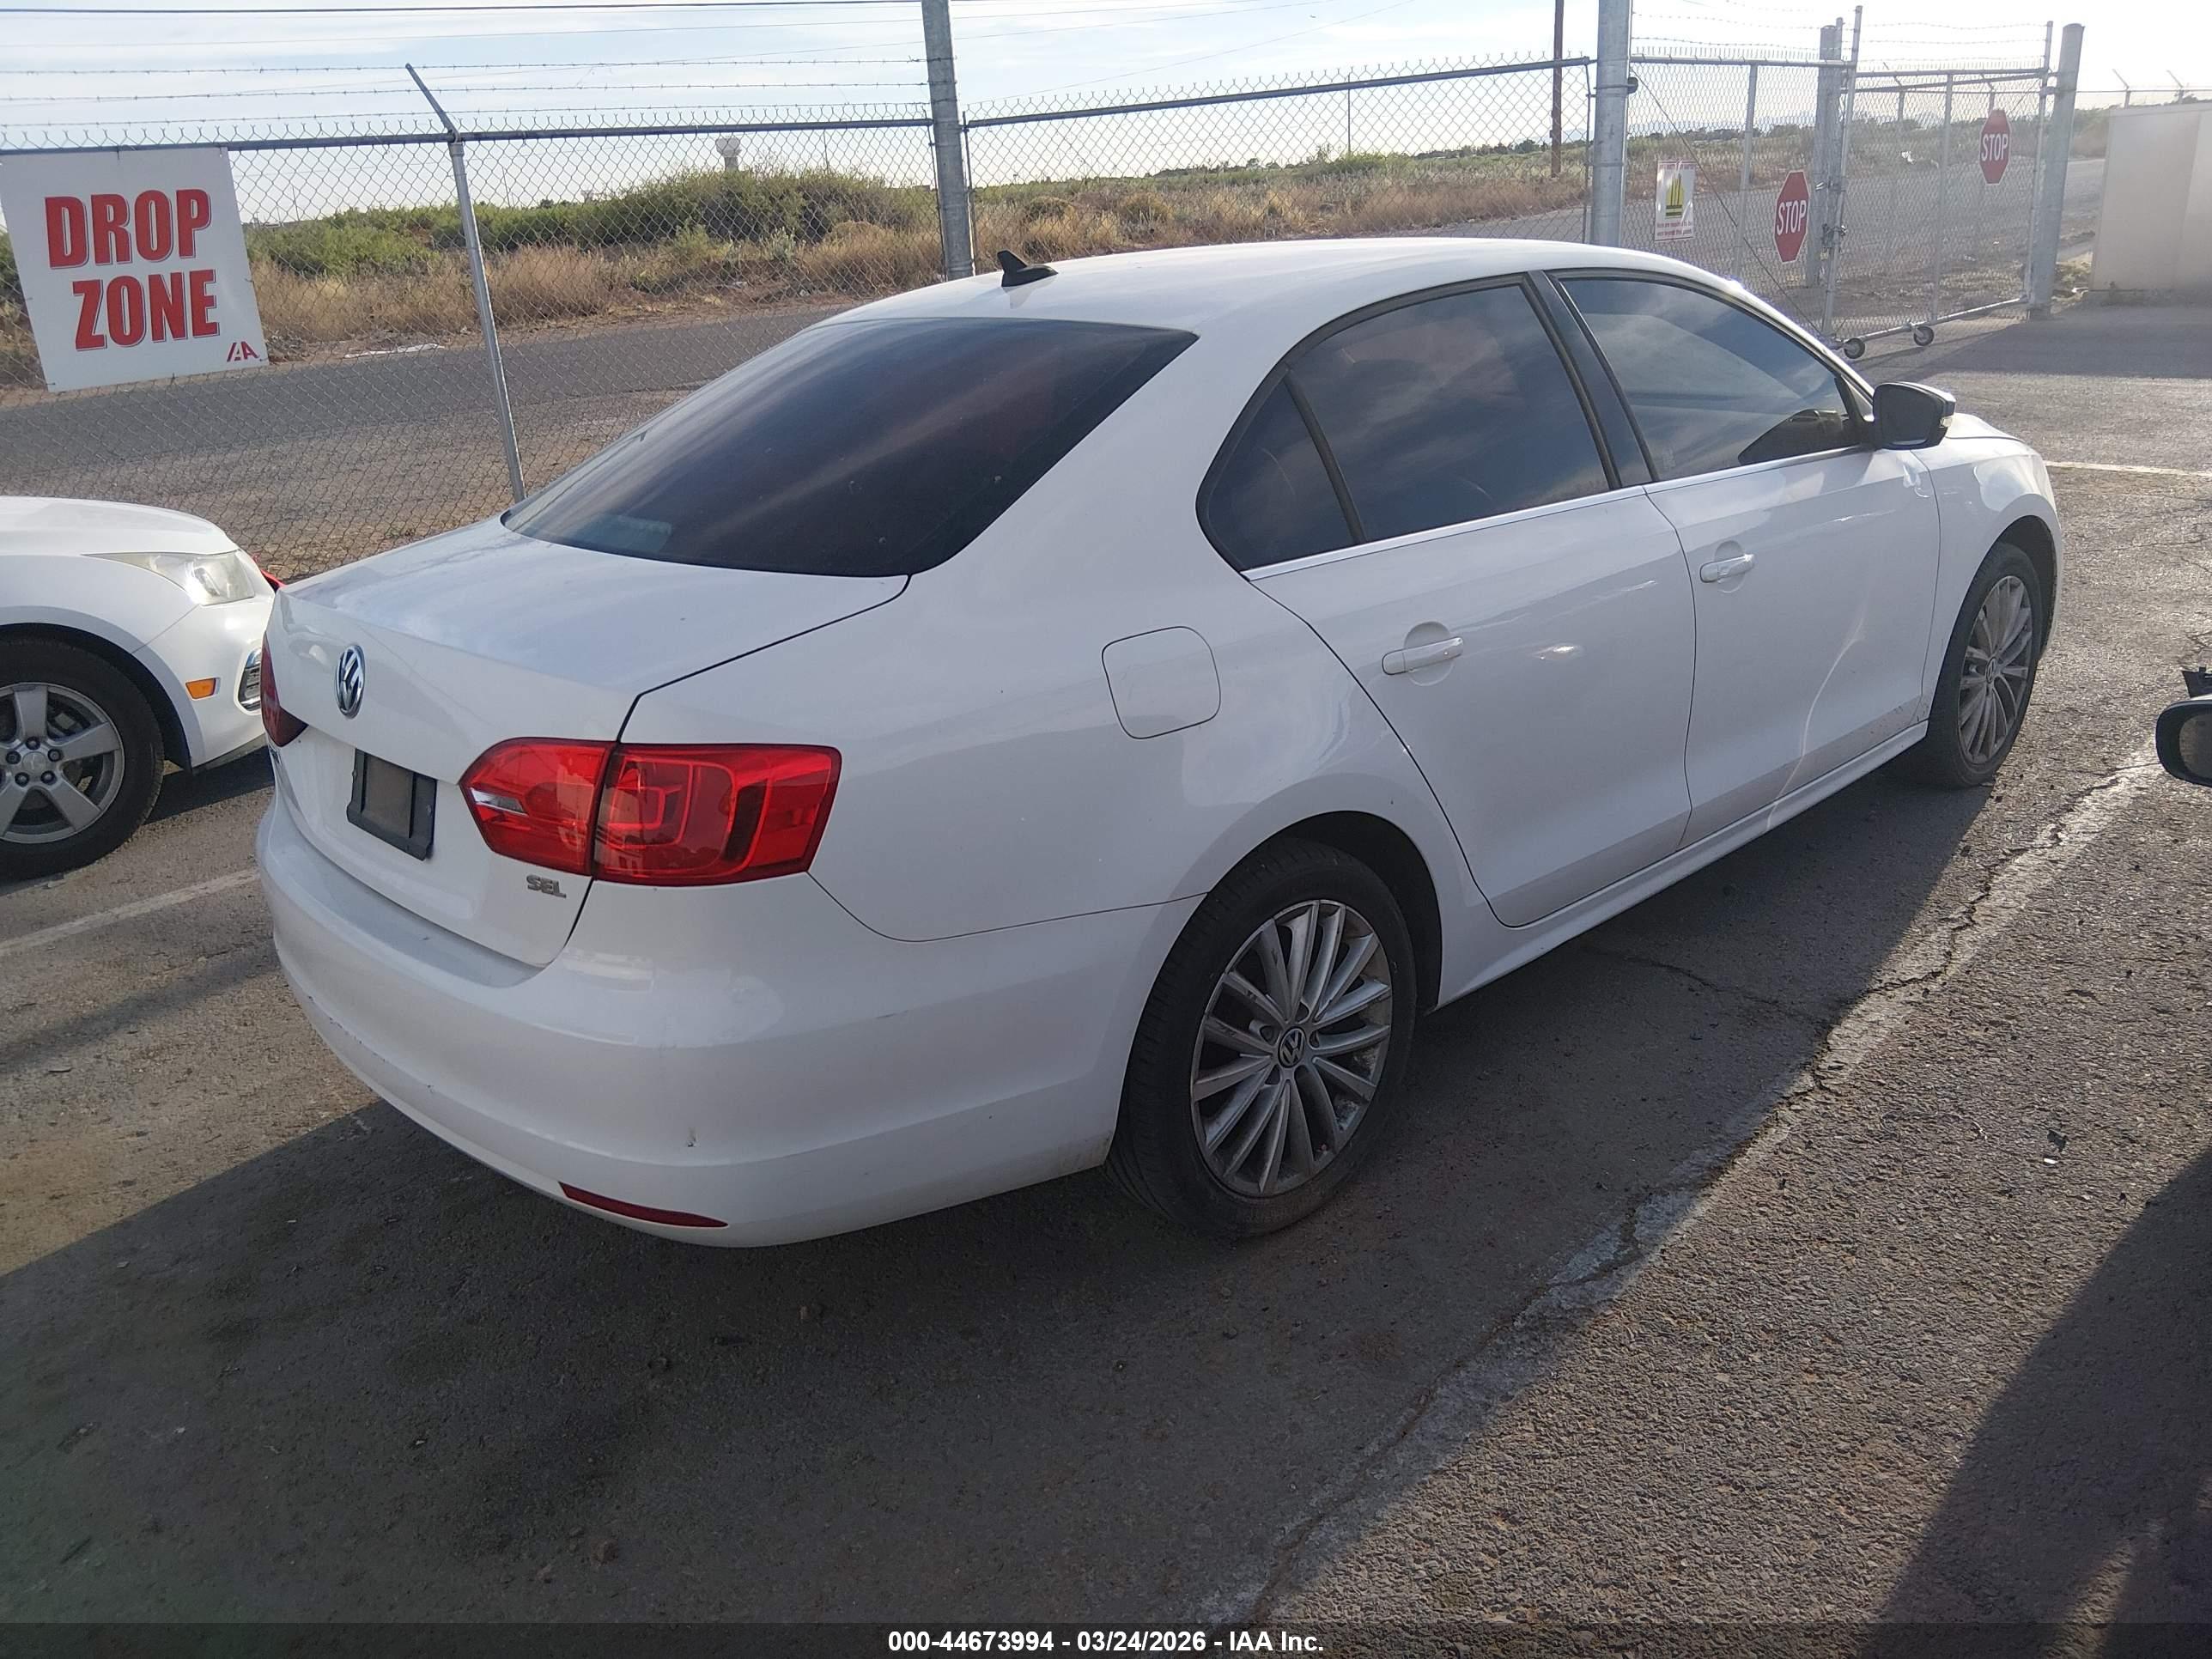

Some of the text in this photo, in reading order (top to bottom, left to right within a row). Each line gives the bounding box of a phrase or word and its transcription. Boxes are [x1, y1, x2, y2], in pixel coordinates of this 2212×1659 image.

[1981, 133, 2008, 161] STOP
[45, 189, 211, 269] DROP
[1777, 200, 1808, 236] STOP
[72, 270, 220, 351] ZONE
[526, 874, 567, 899] SEL
